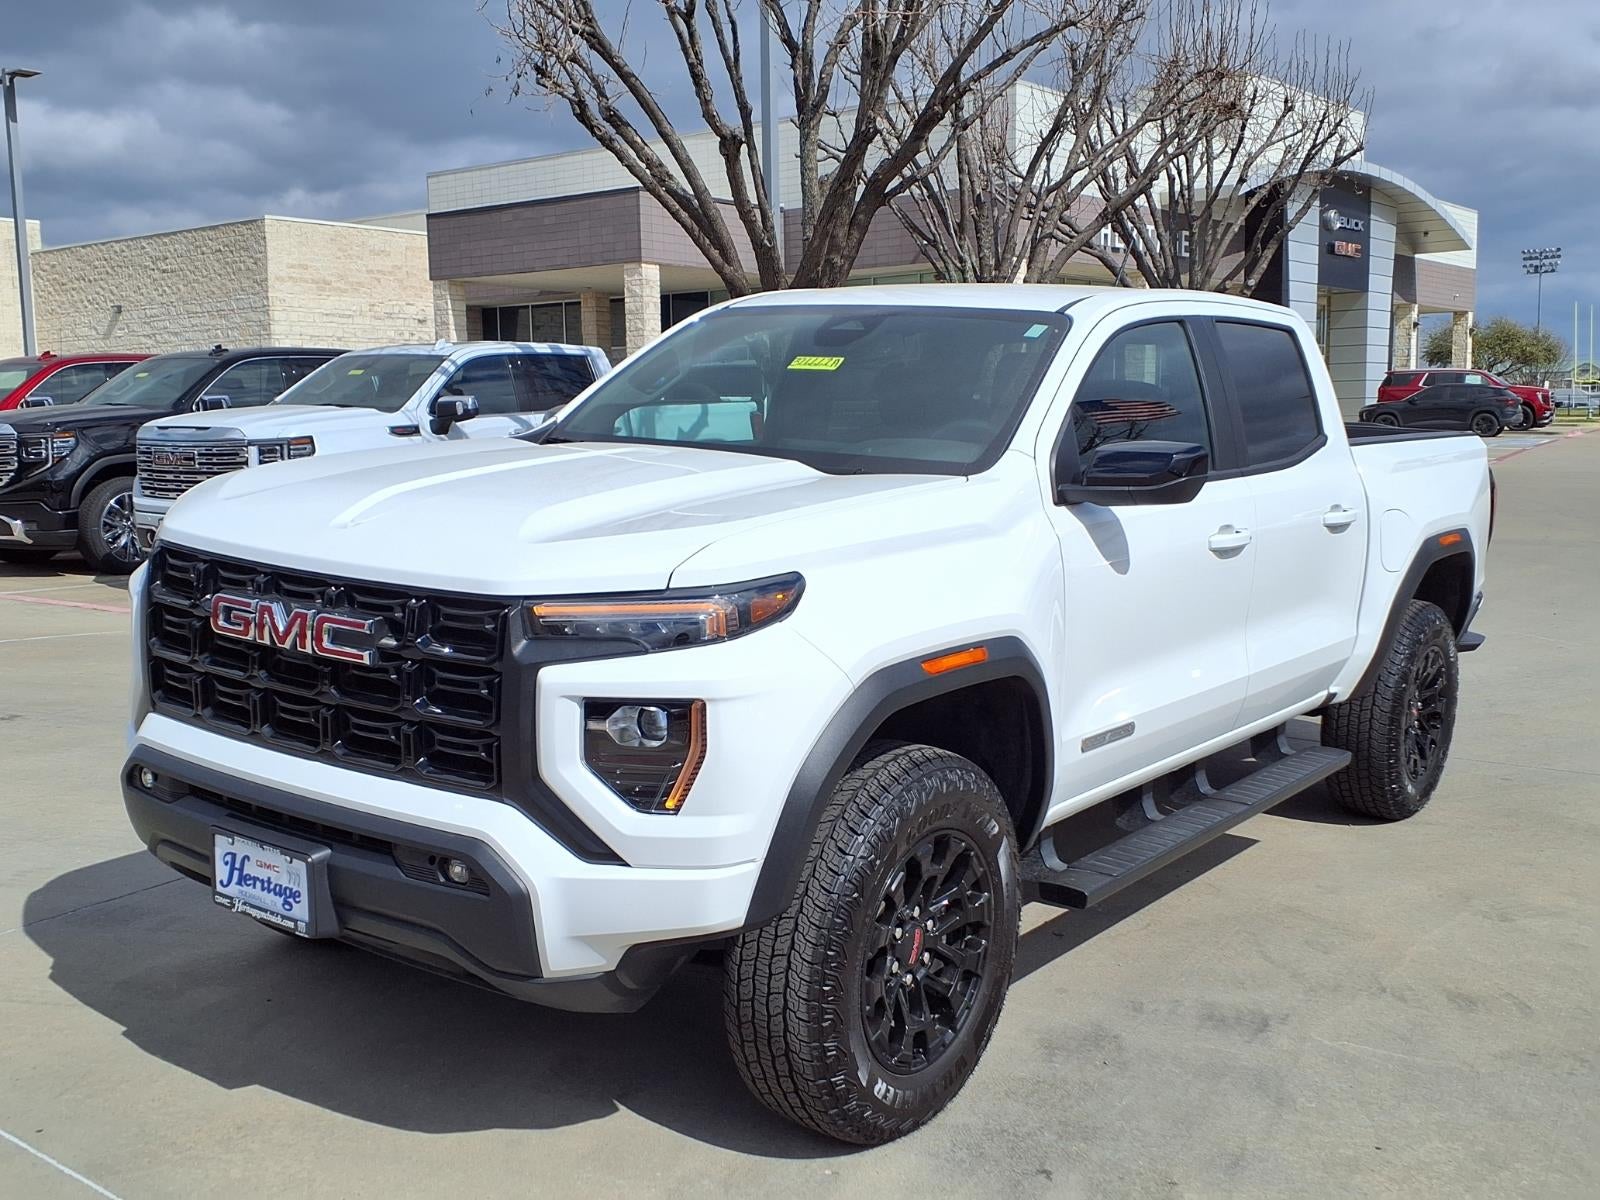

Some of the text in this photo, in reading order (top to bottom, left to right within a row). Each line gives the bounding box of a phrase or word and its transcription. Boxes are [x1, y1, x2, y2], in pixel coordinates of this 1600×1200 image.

[1339, 216, 1364, 231] BUICK
[1335, 240, 1362, 258] GMC
[154, 452, 194, 465] GMC
[210, 593, 374, 665] GMC
[255, 859, 281, 873] GMC
[219, 851, 302, 911] Heritage
